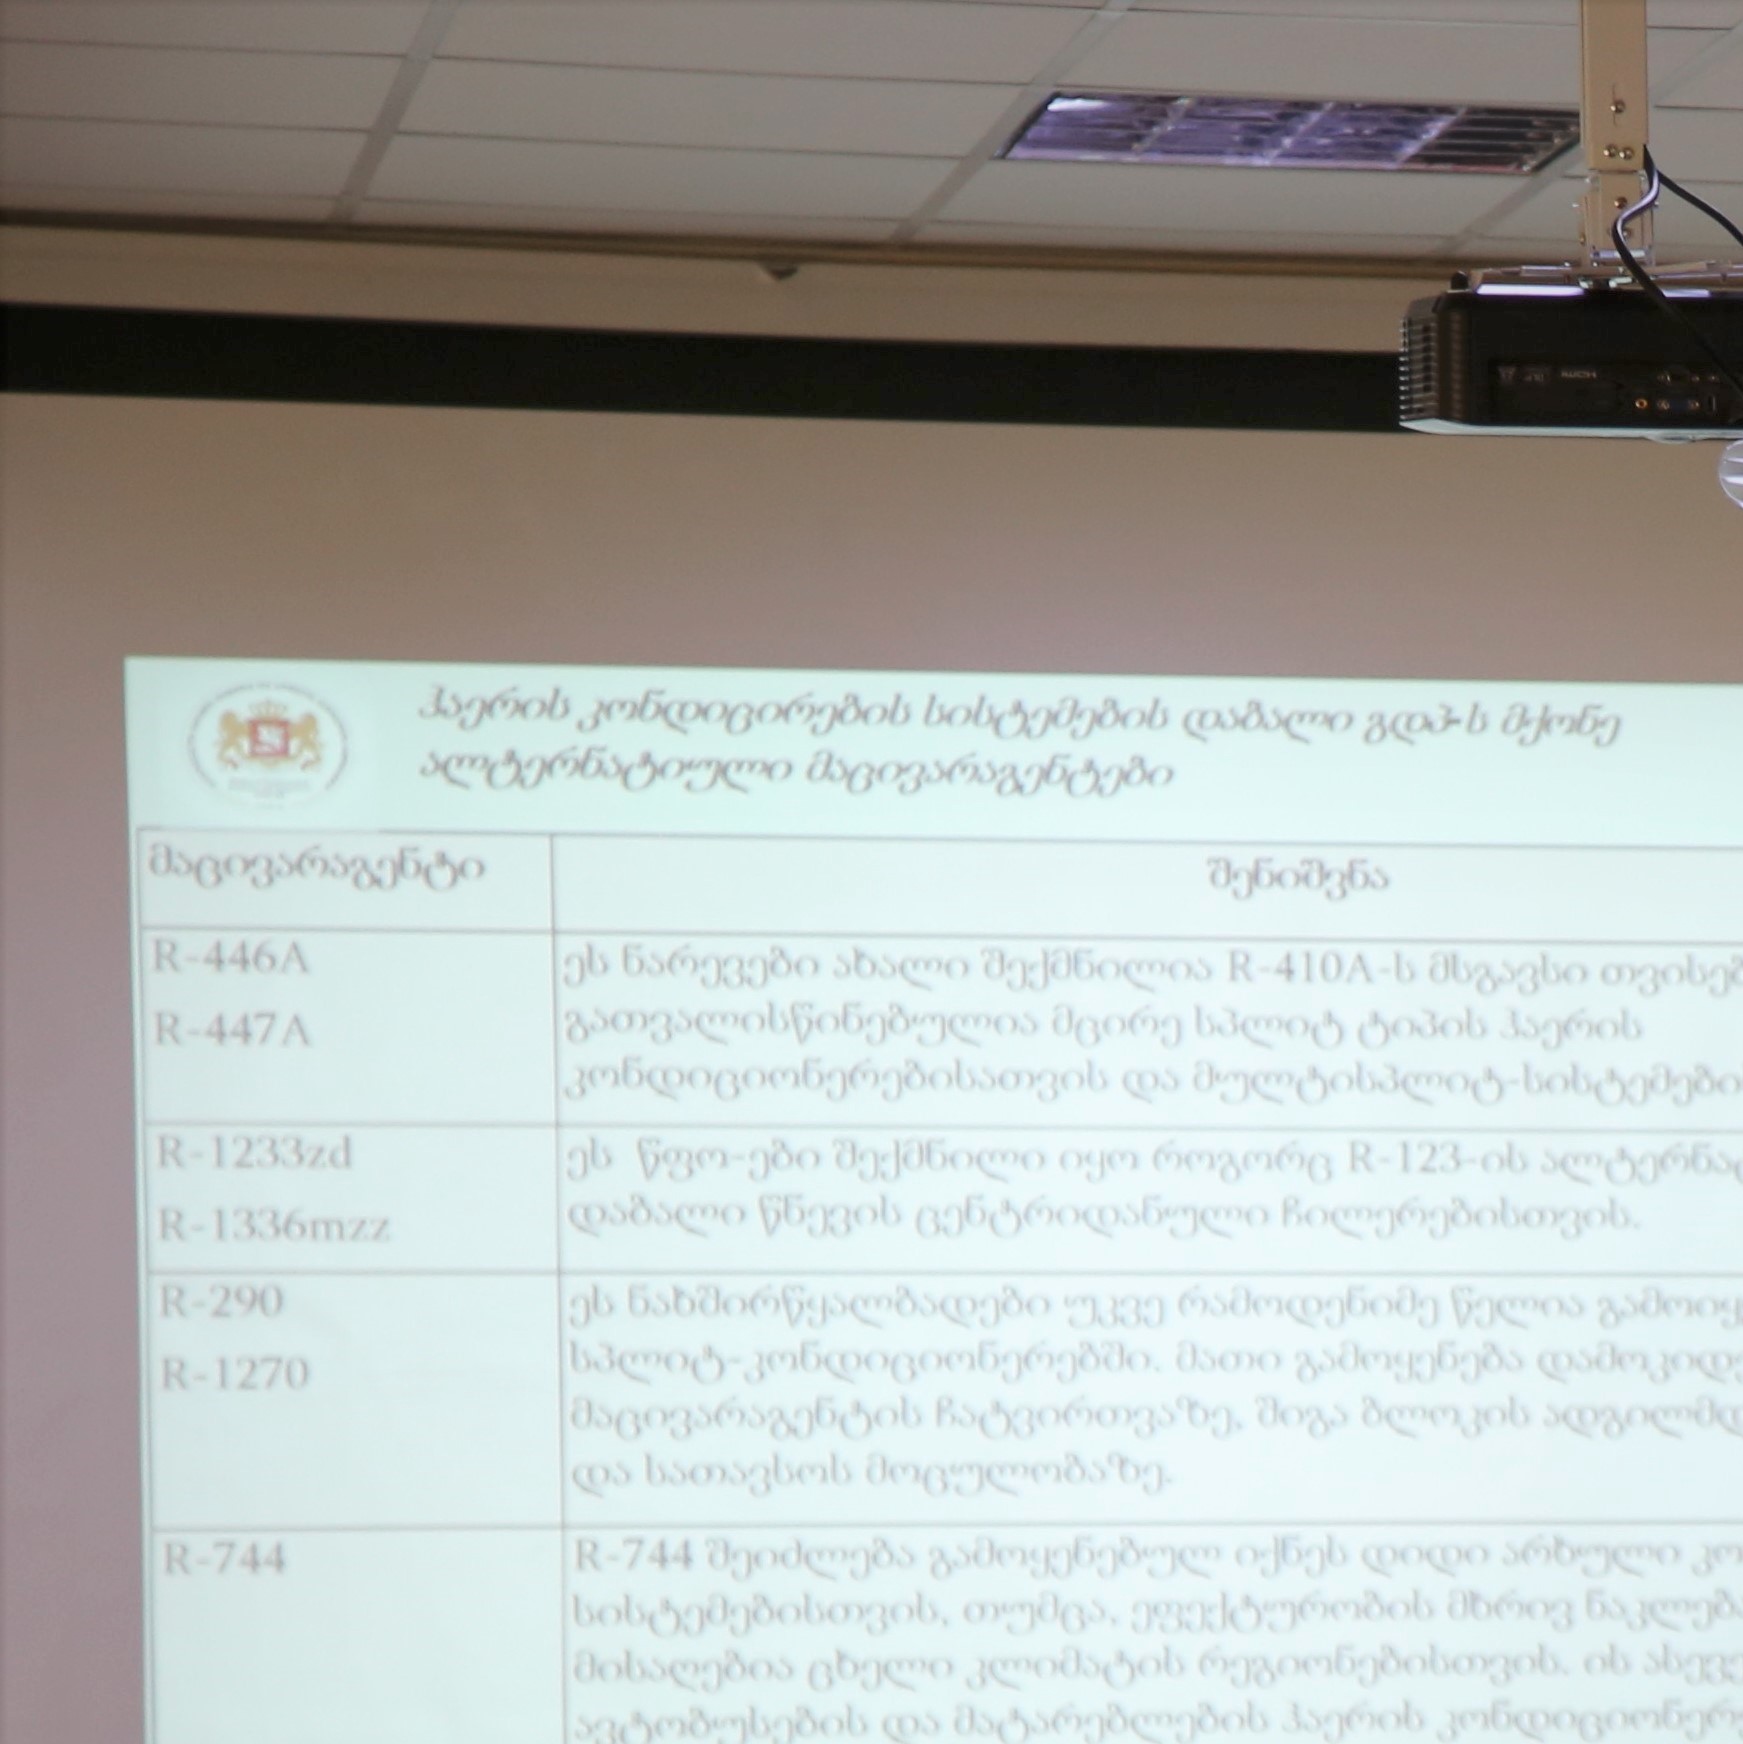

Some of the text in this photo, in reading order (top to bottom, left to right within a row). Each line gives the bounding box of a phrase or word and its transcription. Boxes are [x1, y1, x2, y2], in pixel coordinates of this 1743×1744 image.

[418, 684, 572, 732] ჰაერის
[575, 688, 913, 738] კონდიცირების
[923, 692, 1170, 741] სისტემების
[1181, 698, 1356, 745] დაბალი
[1500, 702, 1623, 749] მქონე
[419, 745, 1176, 798] ალტერნატიული მაცივარაგენტები
[148, 842, 487, 891] მაცივარაგენტი
[1206, 856, 1391, 902] შენიშვნა
[153, 937, 311, 974] R-446A
[563, 942, 611, 988] ეს
[622, 943, 821, 989] ნარევები
[833, 946, 970, 993] ახალი
[981, 946, 1213, 993] შექმნილია
[1229, 949, 1417, 984] R-410A-ს
[1428, 951, 1590, 996] მსგავსი
[155, 1010, 312, 1047] R-447A
[564, 1000, 1644, 1051] გათვალისწინებულია მცირე სპლიტ ტიპის ჰაერის
[564, 1057, 1109, 1105] კონდიციონერებისათვის
[1122, 1069, 1181, 1104] და
[158, 1134, 353, 1170] R-1233zd
[567, 1135, 614, 1181] ეს
[636, 1137, 822, 1183] წფო-ები
[832, 1137, 1047, 1183] შექმნილი
[1059, 1150, 1140, 1182] იყო
[1152, 1140, 1334, 1183] როგორც
[1349, 1140, 1529, 1174] R-123-ის
[159, 1206, 390, 1242] R-1336mzz
[568, 1193, 748, 1238] დაბალი
[758, 1193, 903, 1238] წნევის
[915, 1194, 1271, 1239] ცენტრიდანული
[161, 1282, 286, 1319] R-290
[568, 1283, 616, 1329] ეს
[628, 1283, 1052, 1329] ნახშირწყალბადები
[1064, 1295, 1166, 1328] უკვე
[1178, 1285, 1440, 1329] რამოდენიმე
[1450, 1286, 1586, 1330] წელია
[162, 1355, 311, 1391] R-1270
[1176, 1341, 1283, 1371] მათი
[1295, 1340, 1525, 1383] გამოყენება
[570, 1394, 923, 1441] მაცივარაგენტის
[1255, 1395, 1349, 1438] შიგა
[1361, 1395, 1531, 1439] ბლოკის
[571, 1462, 633, 1498] და
[645, 1451, 853, 1497] სათავსოს
[165, 1540, 287, 1575] R-744
[576, 1536, 694, 1572] R-744
[705, 1536, 917, 1581] შეიძლება
[929, 1535, 1222, 1580] გამოყენებულ
[1235, 1534, 1349, 1578] იქნეს
[1361, 1545, 1491, 1578] დიდი
[1502, 1534, 1682, 1578] არხული
[1131, 1588, 1436, 1633] ეფექტურობის
[1447, 1589, 1575, 1632] მხრივ
[573, 1648, 795, 1693] მისაღებია
[807, 1648, 955, 1692] ცხელი
[965, 1645, 1186, 1691] კლიმატის
[1583, 1642, 1632, 1675] ის
[1282, 1699, 1426, 1744] ჰაერის
